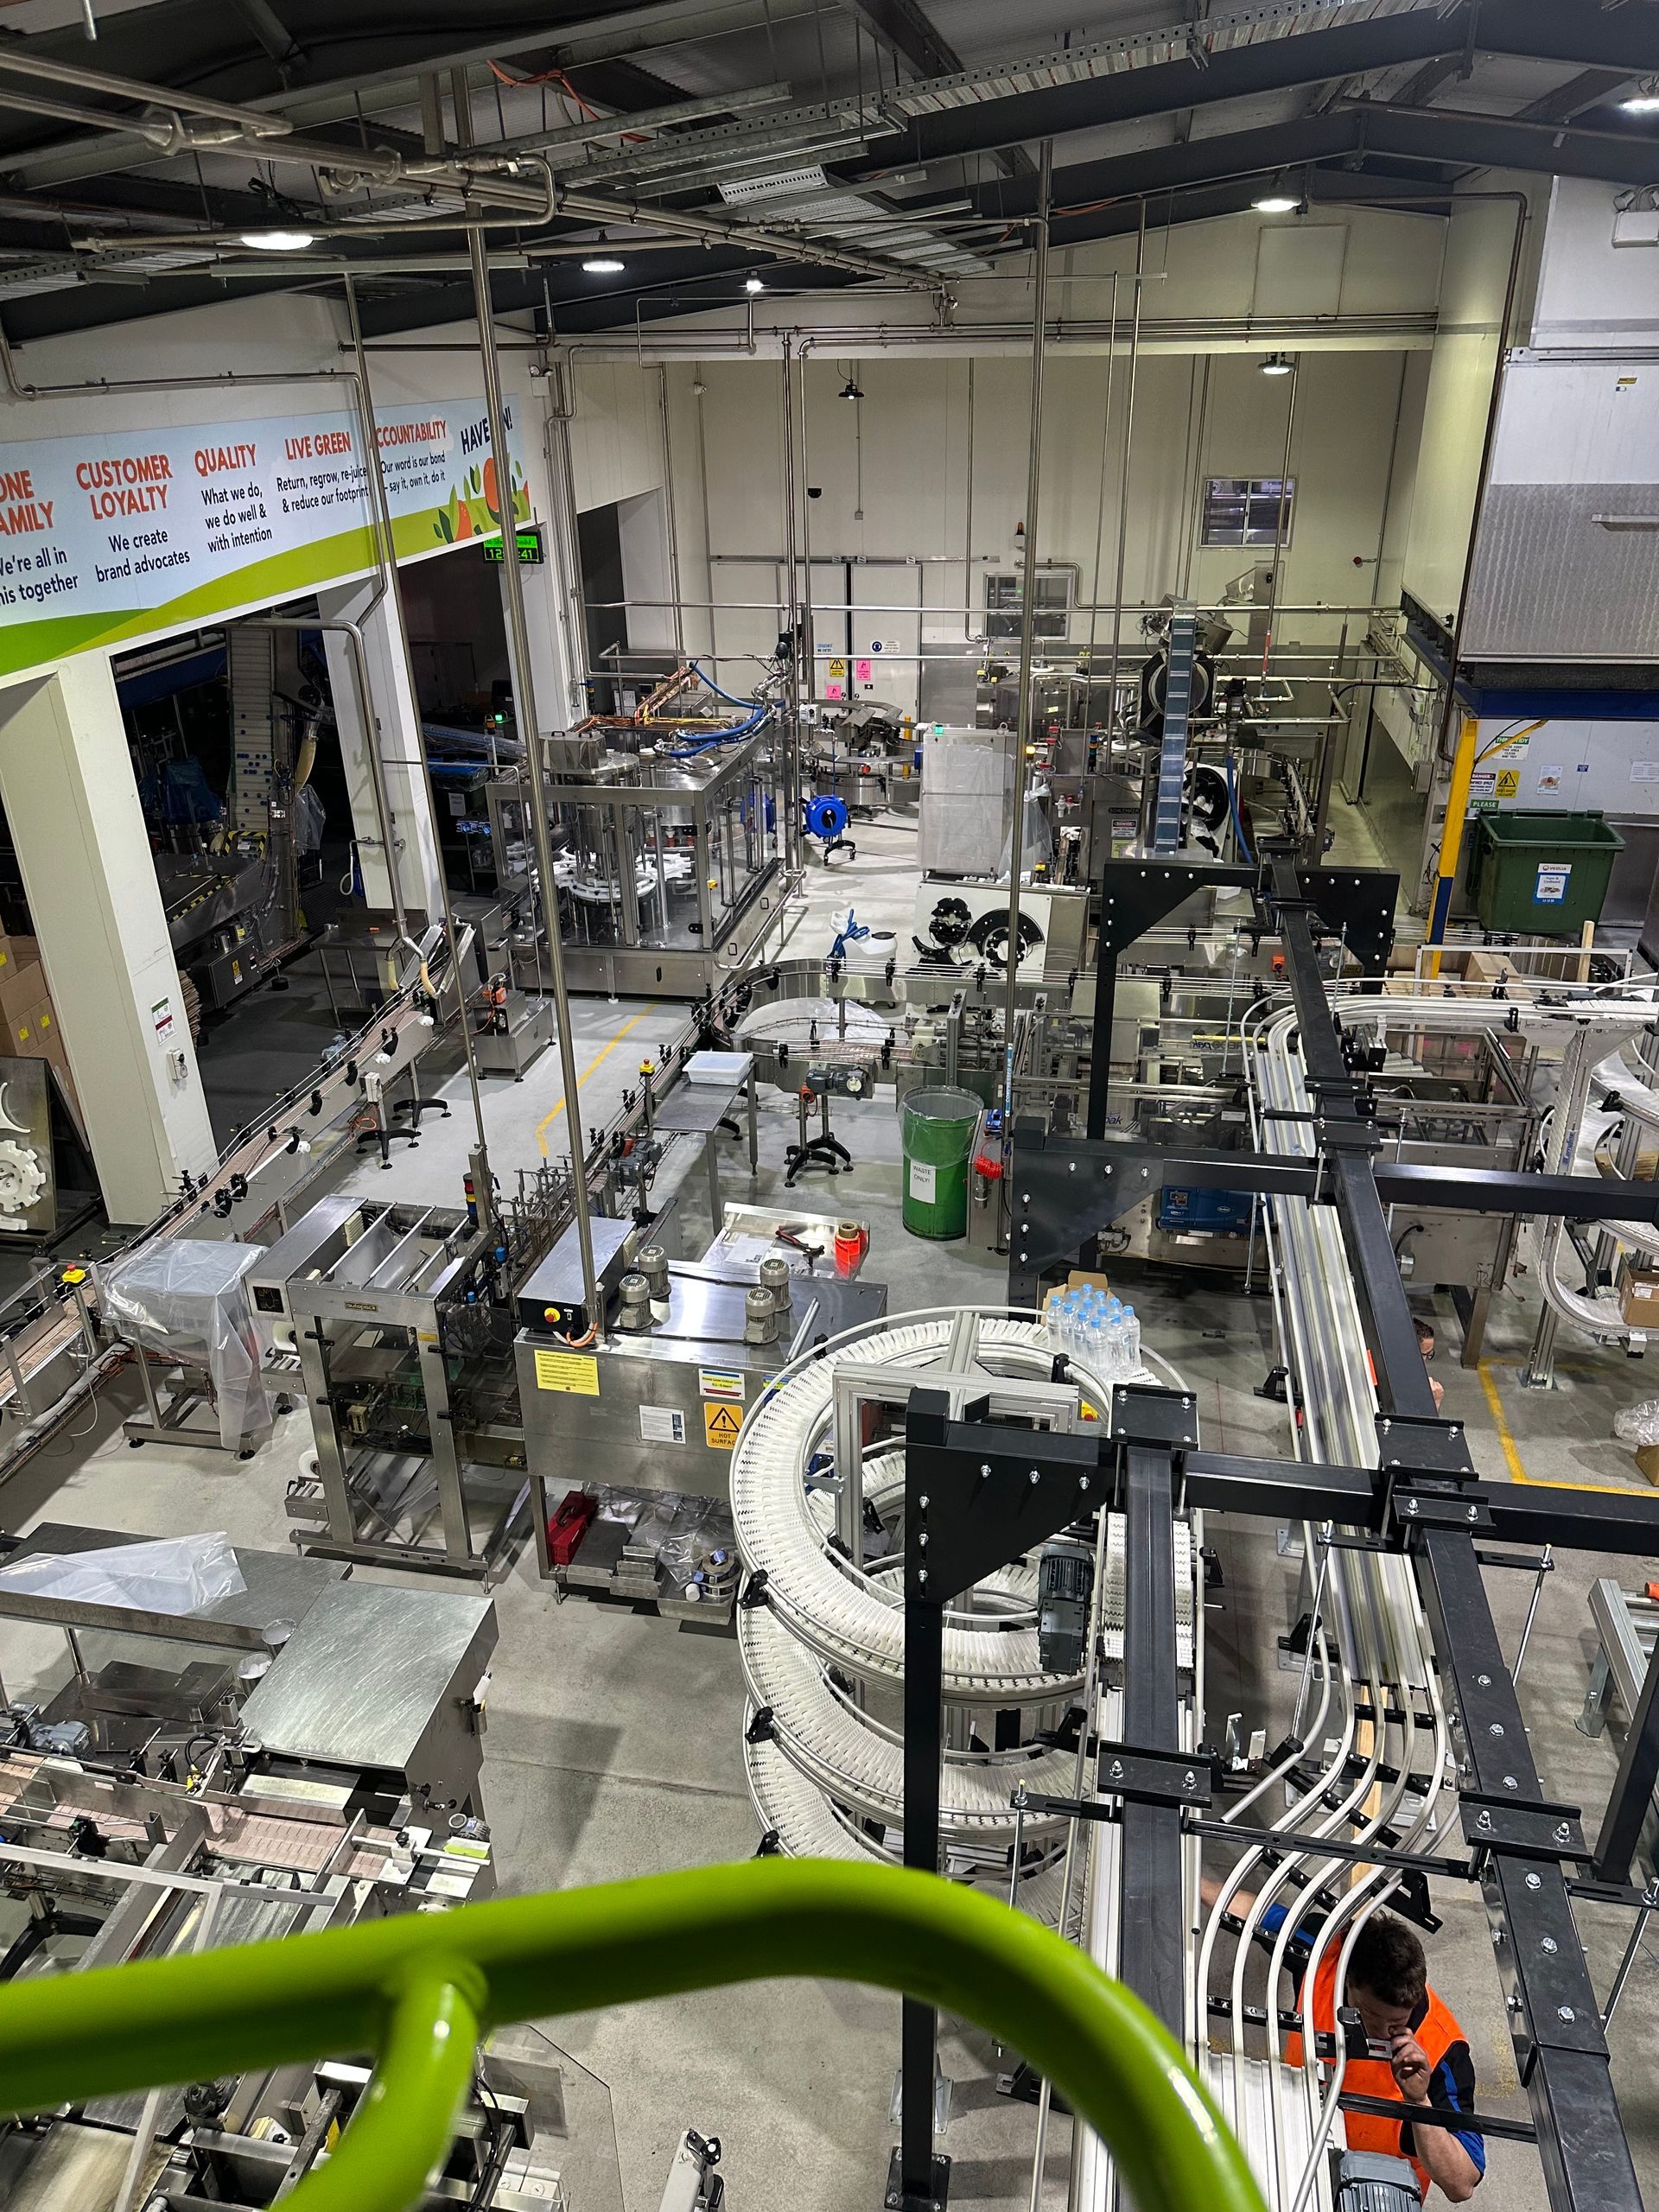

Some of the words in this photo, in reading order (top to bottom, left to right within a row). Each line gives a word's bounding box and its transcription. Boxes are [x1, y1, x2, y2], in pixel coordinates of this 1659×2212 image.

[285, 435, 312, 460] LIVE
[315, 431, 352, 456] GREEN
[369, 420, 447, 448] CCOUNTABILITY
[461, 417, 491, 455] HAVE
[76, 454, 173, 490] CUSTOMER
[194, 443, 257, 477] QUALITY
[381, 460, 393, 474] Our
[394, 456, 411, 472] word
[412, 455, 418, 469] is
[419, 456, 429, 468] our
[429, 450, 446, 465] bond
[276, 476, 308, 493] Return,
[309, 471, 340, 490] regrow,
[340, 464, 367, 483] re-juice
[389, 480, 400, 495] say
[409, 476, 423, 488] own
[431, 469, 440, 483] do
[440, 471, 446, 482] it
[90, 484, 168, 519] LOYALTY
[201, 487, 229, 505] What
[230, 486, 245, 501] we
[248, 481, 263, 499] do,
[282, 499, 290, 513] &
[291, 494, 320, 512] reduce
[321, 493, 334, 506] our
[0, 501, 54, 536] AMILY
[205, 515, 220, 530] we
[223, 509, 236, 526] do
[238, 505, 257, 524] well
[258, 503, 267, 518] &
[108, 534, 130, 552] We
[133, 529, 168, 549] create
[207, 532, 230, 553] with
[231, 526, 272, 548] intention
[35, 547, 51, 569] all
[54, 546, 67, 564] in
[95, 558, 130, 582] brand
[135, 550, 190, 575] advocates
[0, 587, 16, 605] is
[19, 573, 79, 602] together
[913, 1166, 931, 1175] WASTE
[914, 1174, 931, 1183] ONLY!
